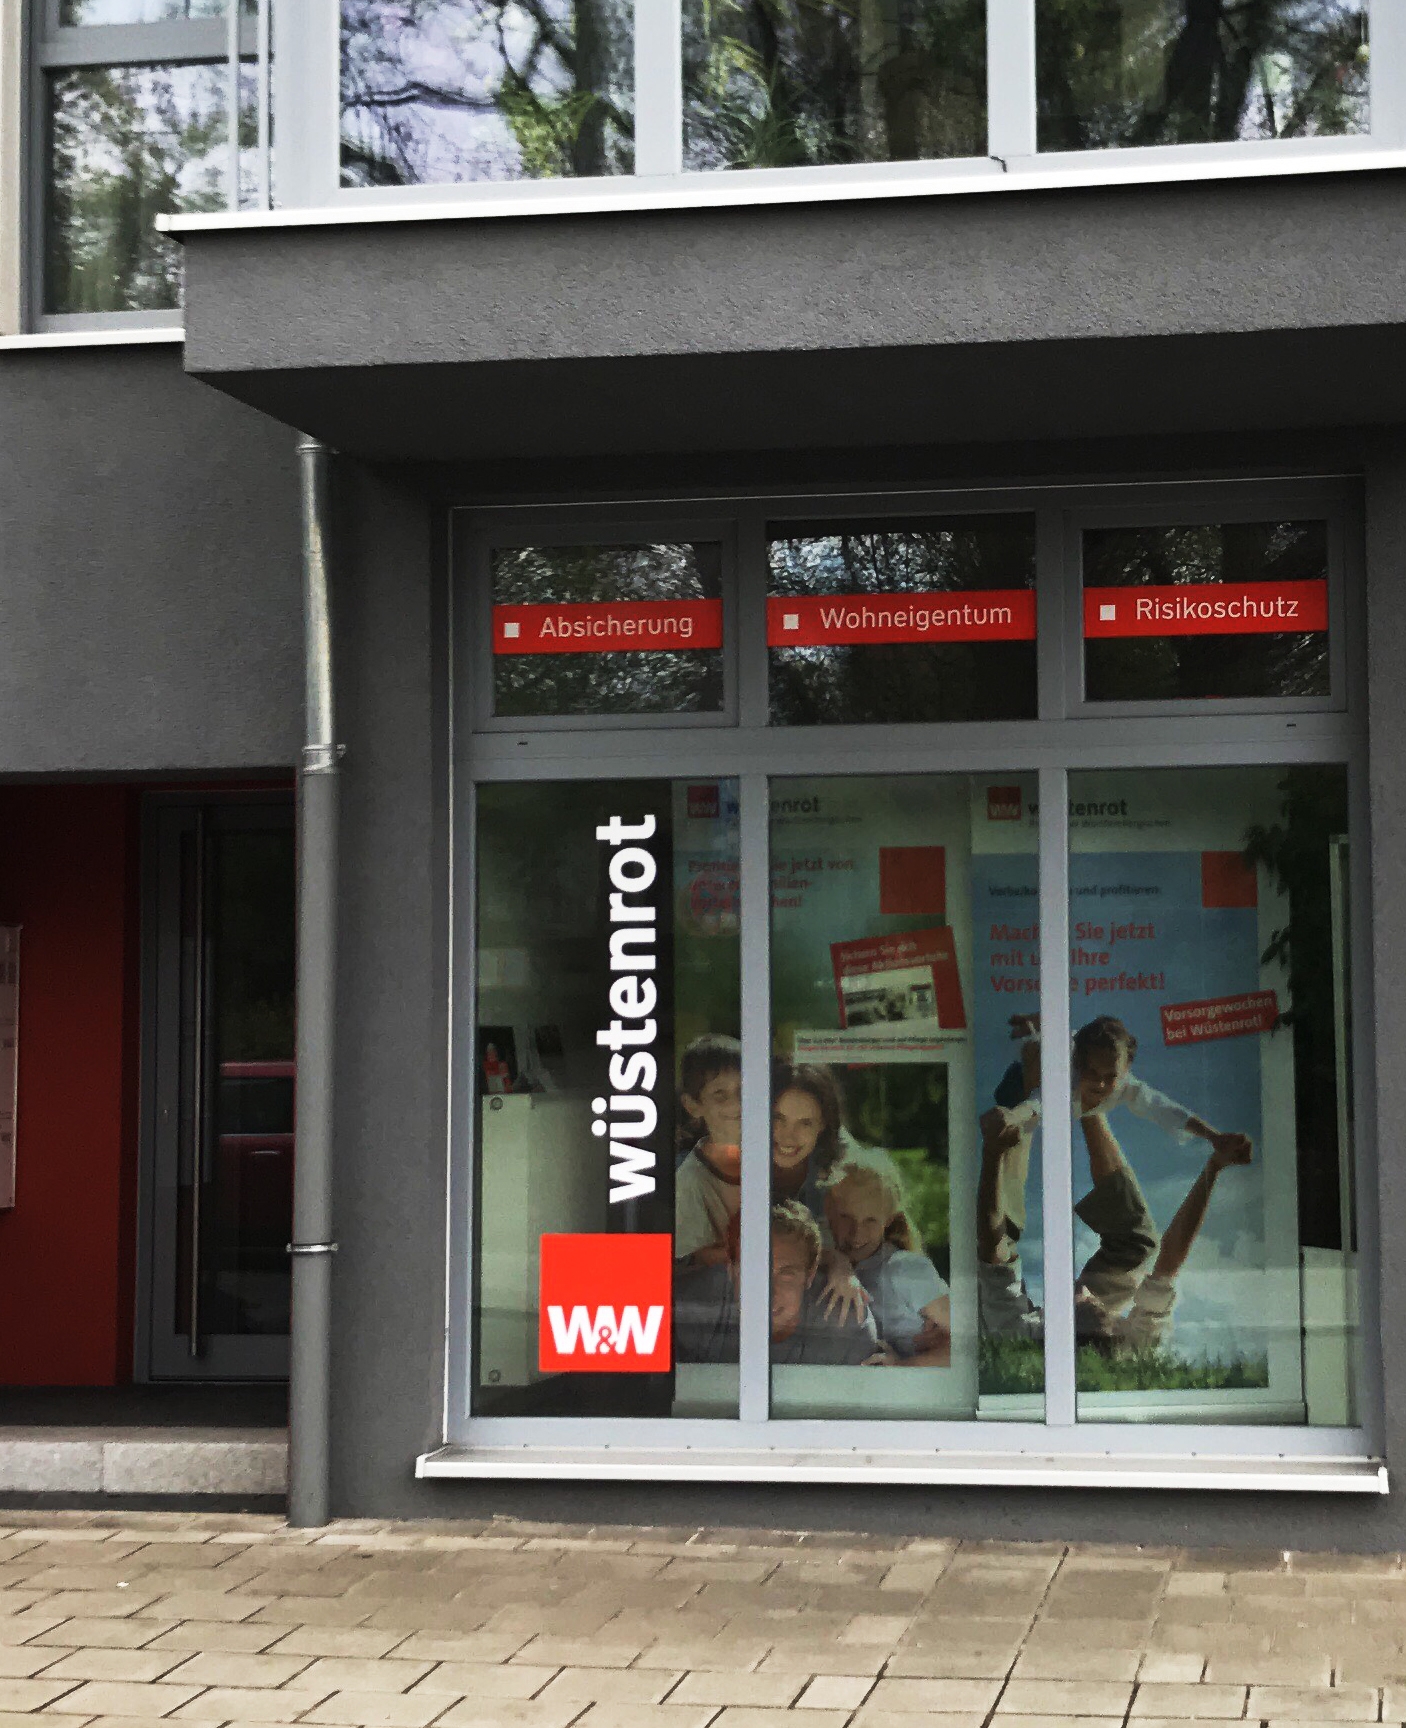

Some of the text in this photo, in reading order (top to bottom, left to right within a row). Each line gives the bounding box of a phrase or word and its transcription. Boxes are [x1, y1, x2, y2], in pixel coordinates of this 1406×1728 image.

[819, 603, 1012, 632] Wohneigentum
[1136, 595, 1299, 620] Risikoschutz
[539, 613, 694, 638] Absicherung
[1075, 921, 1104, 940] Sie
[1109, 921, 1156, 946] jetzt
[989, 947, 1024, 967] mit
[1070, 947, 1111, 967] Ihre
[1085, 971, 1166, 996] perfekt!
[591, 814, 658, 1203] wüstenrot
[1163, 996, 1273, 1022] Vorsorgewochen
[1165, 1024, 1187, 1041] bei
[547, 1305, 665, 1355] W&W
